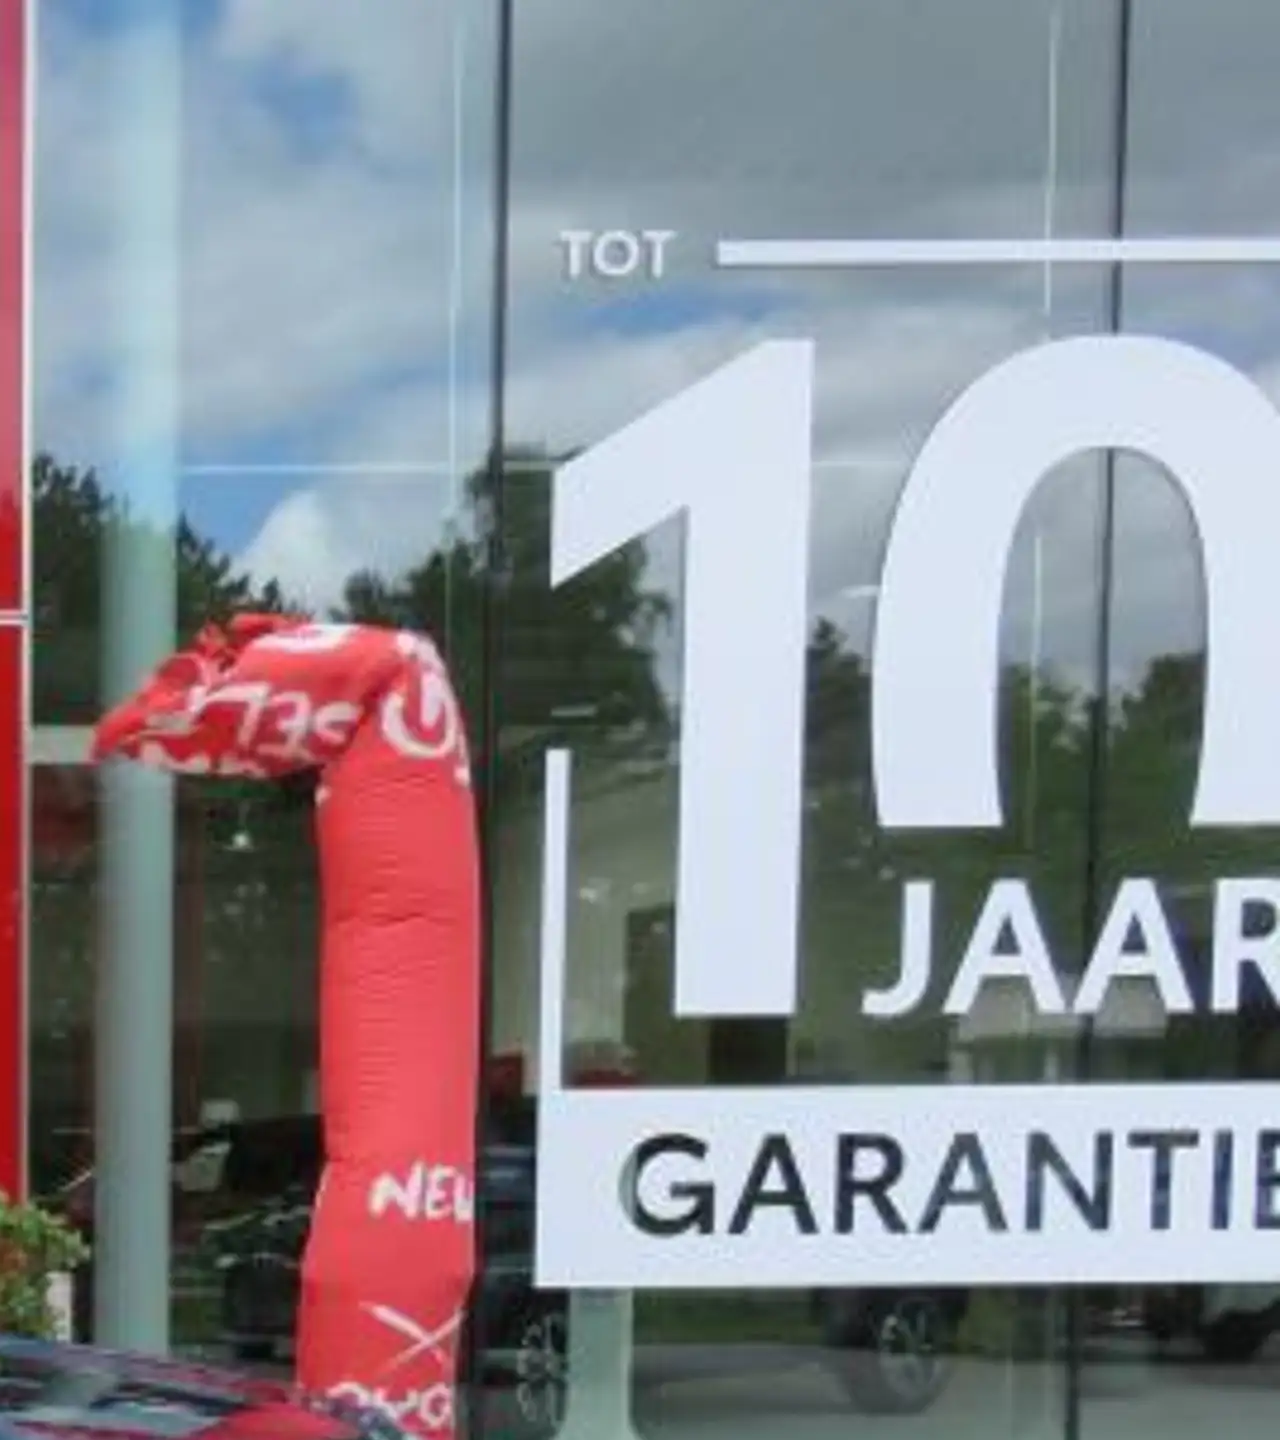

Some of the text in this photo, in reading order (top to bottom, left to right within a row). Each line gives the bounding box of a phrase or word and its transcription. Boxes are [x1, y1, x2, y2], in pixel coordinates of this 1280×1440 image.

[559, 229, 679, 278] TOT
[552, 335, 1280, 1020] 10
[861, 877, 1280, 1016] JAAR
